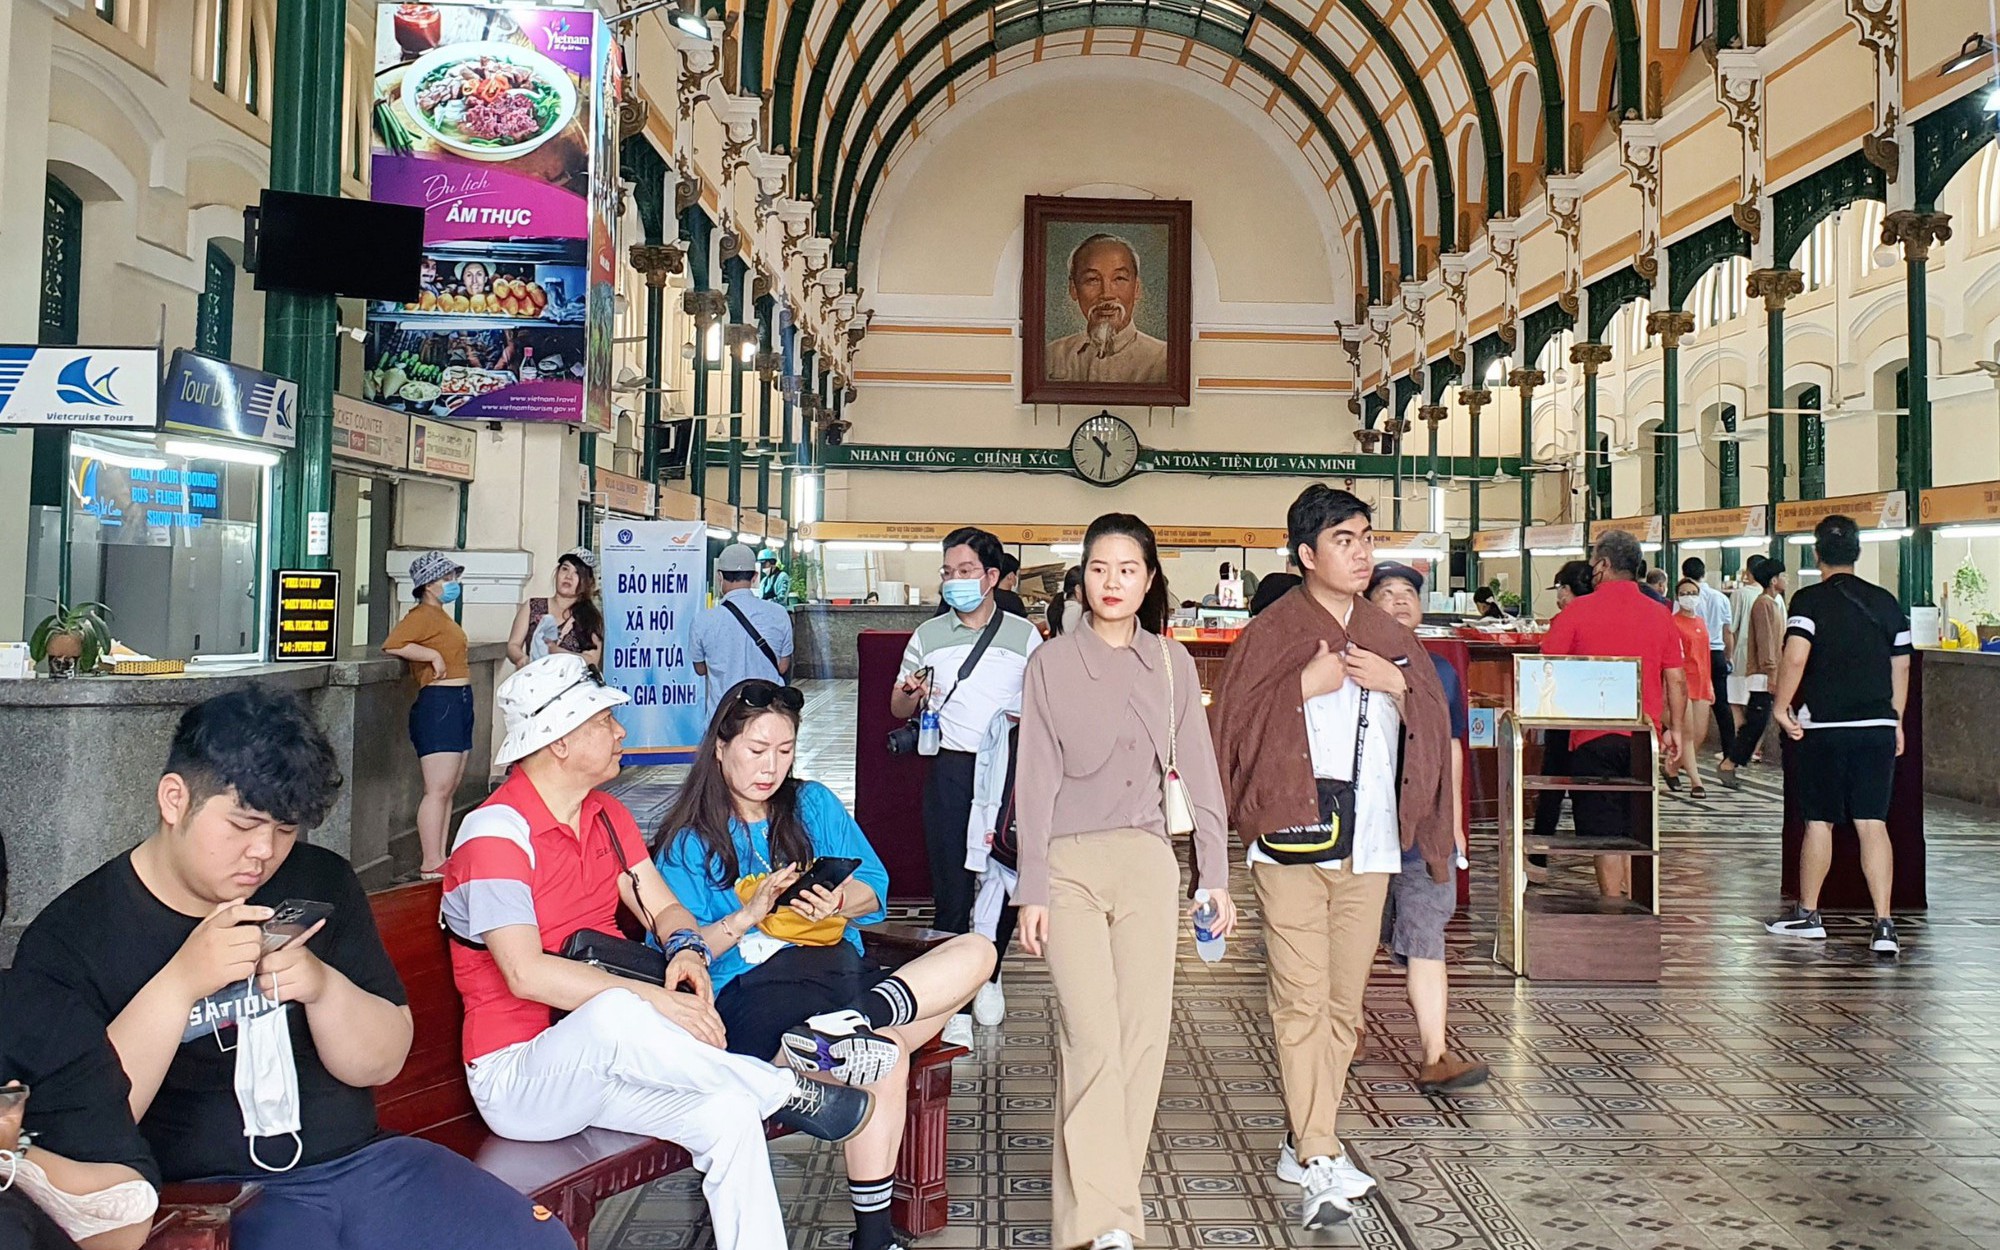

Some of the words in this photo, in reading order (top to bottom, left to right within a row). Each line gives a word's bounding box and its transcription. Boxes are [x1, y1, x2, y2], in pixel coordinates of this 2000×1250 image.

[541, 26, 590, 51] Vietnam
[422, 173, 457, 202] Du
[461, 169, 491, 195] lịch
[445, 199, 477, 223] ẨM
[480, 207, 532, 228] THỰC
[180, 369, 210, 405] Tour
[481, 404, 576, 414] www.vietnamtourism.gov.vn
[509, 395, 577, 403] www.vietnam.travel
[46, 412, 101, 421] Vietcruise
[101, 413, 134, 422] Tours
[355, 413, 383, 434] COUNTER
[849, 449, 901, 462] NHANH
[905, 447, 956, 464] CHÓNG
[974, 448, 1022, 465] CHÍNH
[1028, 449, 1059, 466] XÁC
[1153, 455, 1171, 467] AN
[1173, 452, 1210, 468] TOÀN
[1219, 453, 1251, 470] TIỆN
[1255, 455, 1279, 470] LỢI
[1288, 454, 1317, 470] VĂN
[1319, 457, 1356, 470] MINH
[130, 468, 154, 481] DAILY
[156, 468, 179, 484] TOUR
[131, 486, 149, 503] BUS
[155, 490, 184, 506] FLIGHT
[191, 492, 217, 509] TRAIN
[147, 509, 172, 526] SHOW
[618, 565, 647, 594] BẢO
[652, 562, 688, 594] HIỂM
[626, 606, 644, 631] XÃ
[650, 605, 674, 635] HỘI
[614, 637, 651, 668] ĐIỂM
[655, 644, 684, 672] TỰA
[634, 685, 657, 706] GIA
[662, 679, 696, 706] ĐÌNH
